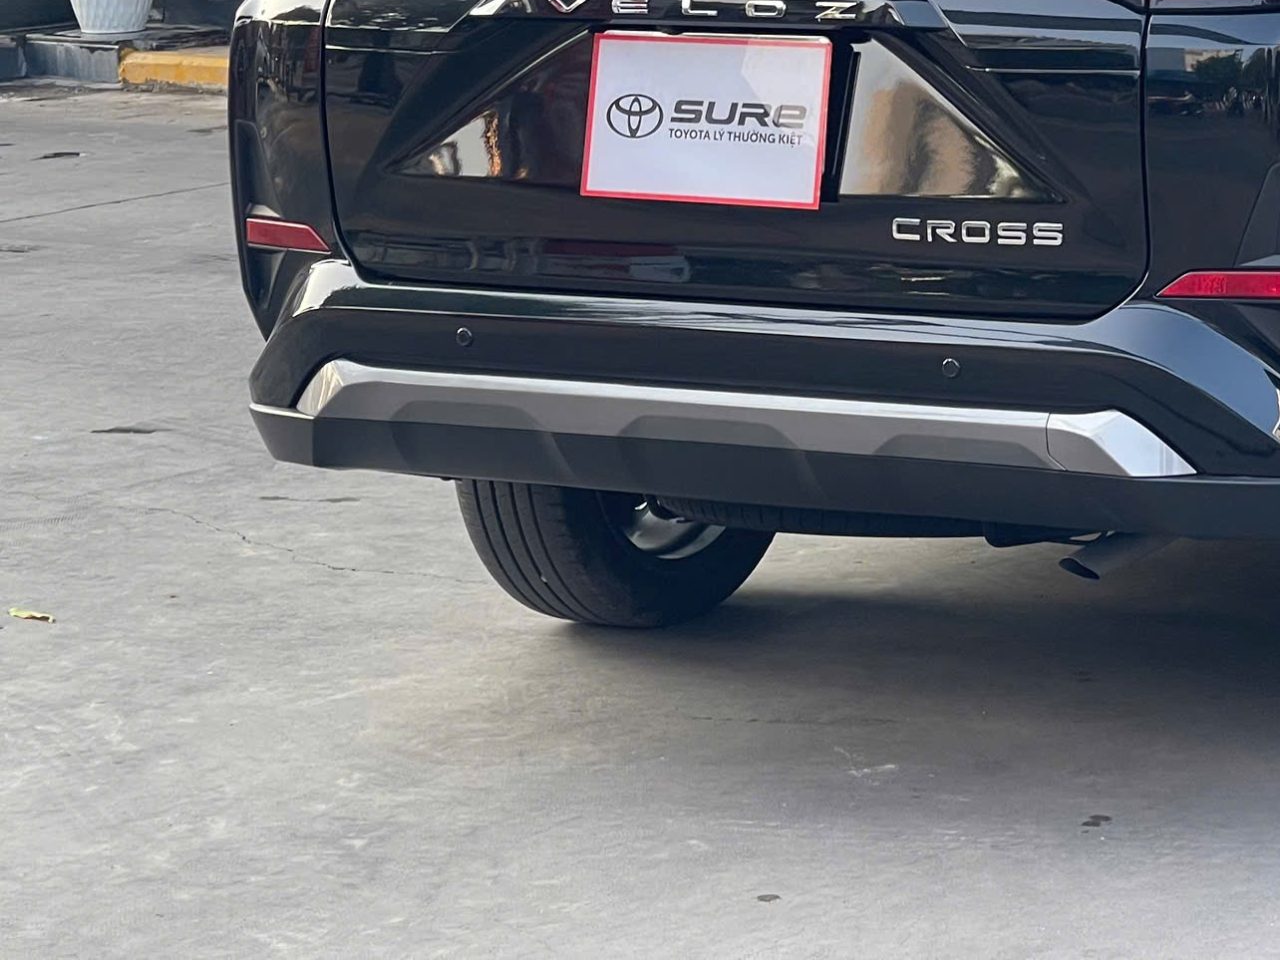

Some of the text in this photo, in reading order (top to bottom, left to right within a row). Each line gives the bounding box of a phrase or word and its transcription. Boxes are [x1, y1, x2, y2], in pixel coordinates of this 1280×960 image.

[669, 127, 803, 148] TOYOTA LÝ THƯỜNG KIỆT
[892, 217, 1063, 246] CROSS
